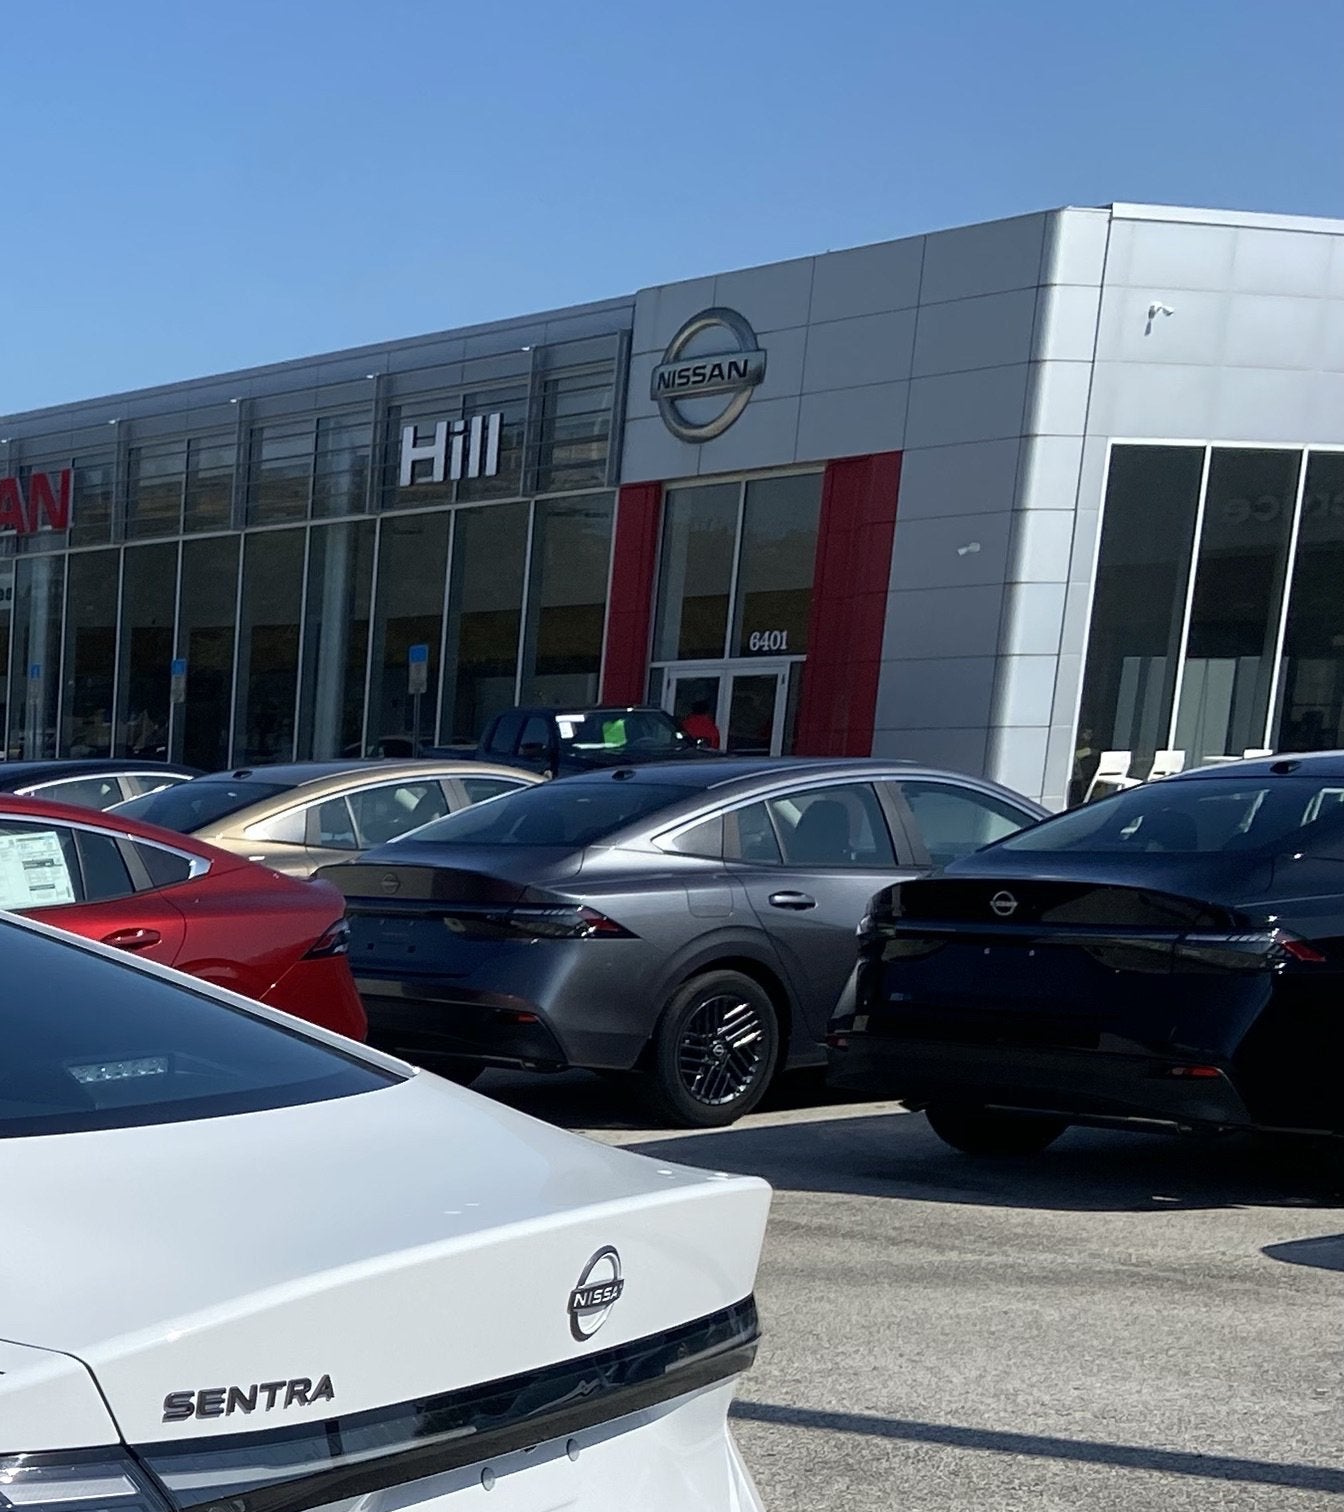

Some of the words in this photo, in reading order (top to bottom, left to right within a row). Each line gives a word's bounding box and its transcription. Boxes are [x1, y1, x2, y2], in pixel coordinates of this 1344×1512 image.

[657, 359, 748, 391] NISSAN
[399, 412, 502, 487] Hill
[749, 630, 788, 651] 6401
[162, 1374, 335, 1423] SENTRA
